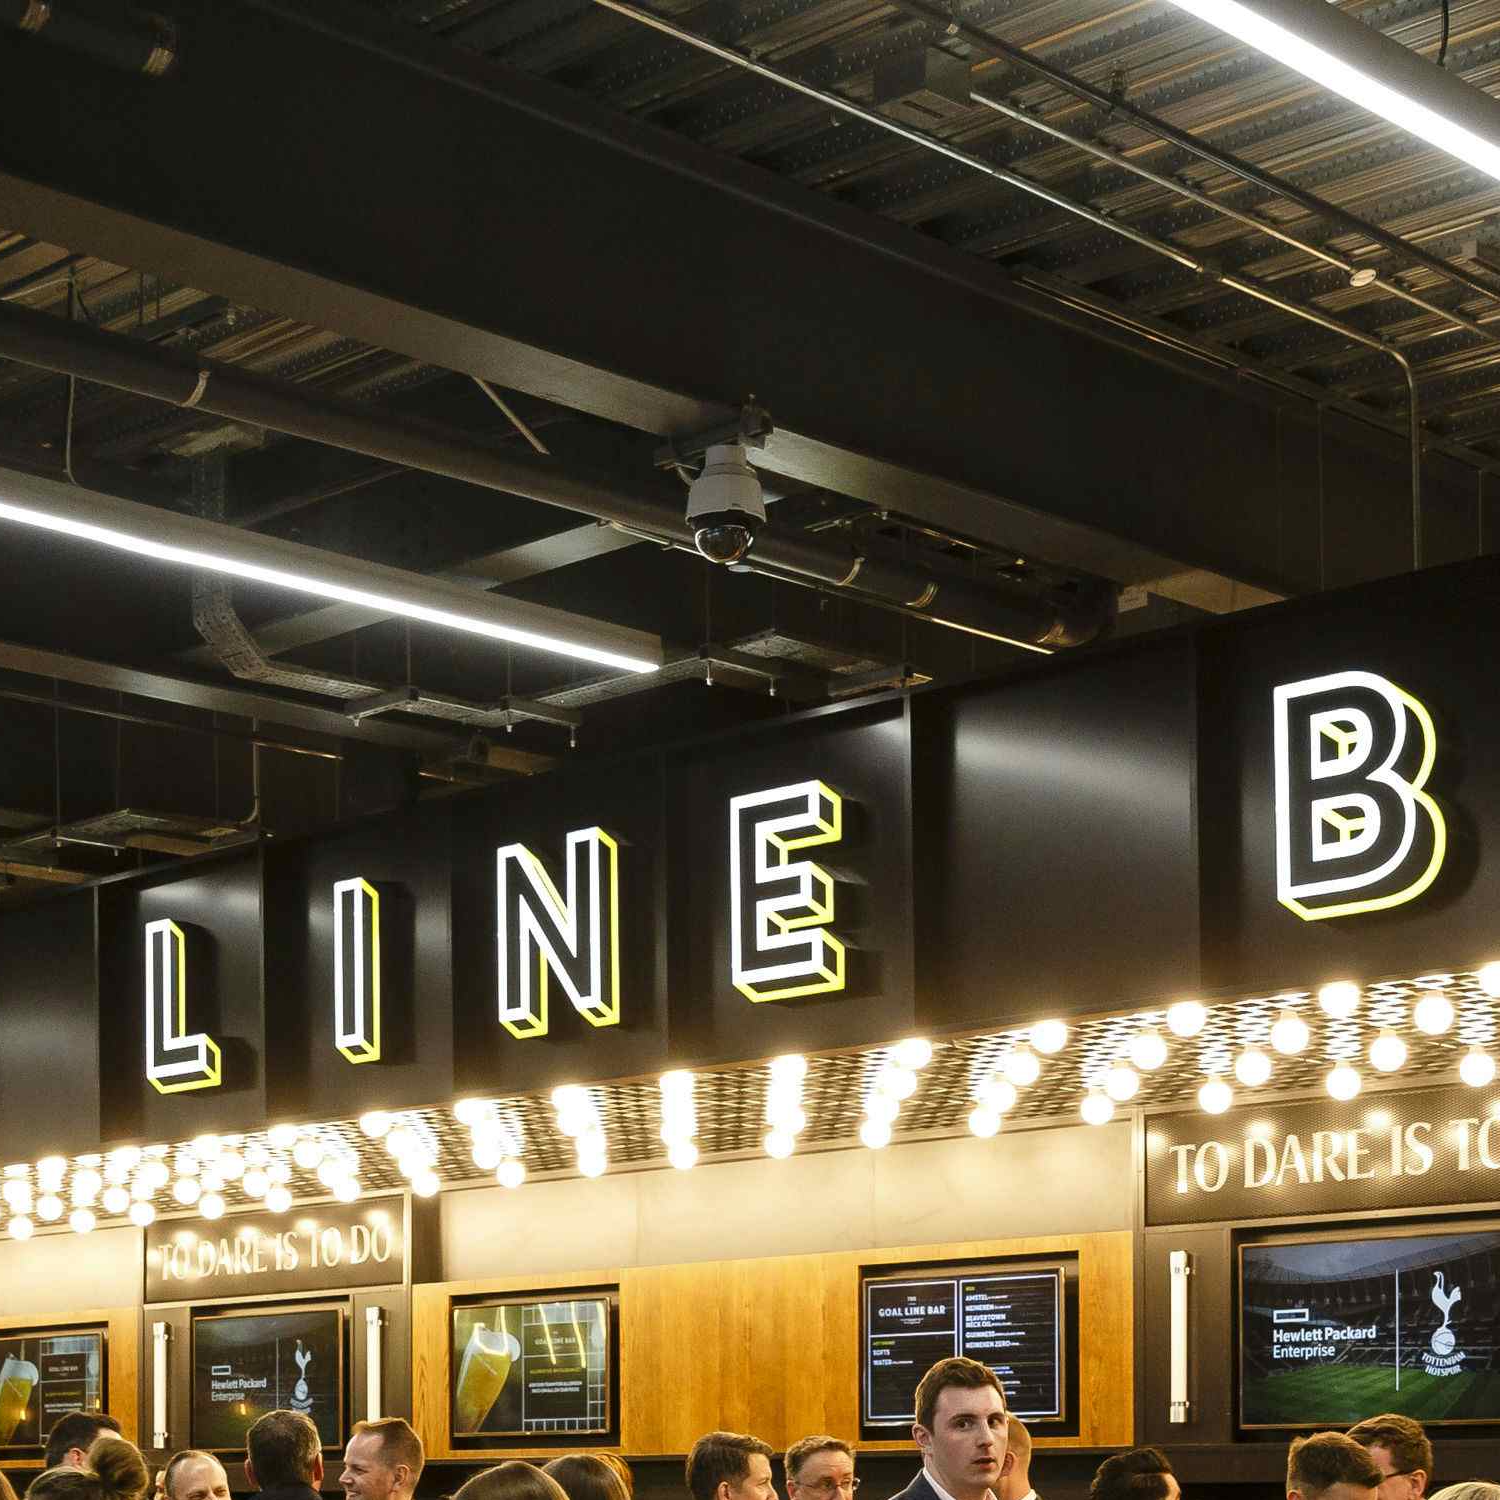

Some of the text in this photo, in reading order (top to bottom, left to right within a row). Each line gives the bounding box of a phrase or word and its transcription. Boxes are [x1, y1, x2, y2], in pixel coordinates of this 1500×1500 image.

[145, 779, 846, 1094] LINE
[1170, 1140, 1229, 1194] TO
[1243, 1129, 1377, 1189] DARE
[1390, 1121, 1433, 1177] IS
[159, 1222, 392, 1281] TO DARE IS TO DO
[878, 1304, 946, 1317] GOAL LINE BAR
[1273, 1325, 1377, 1343] Hewlett Packard
[1273, 1344, 1336, 1360] Enterprise
